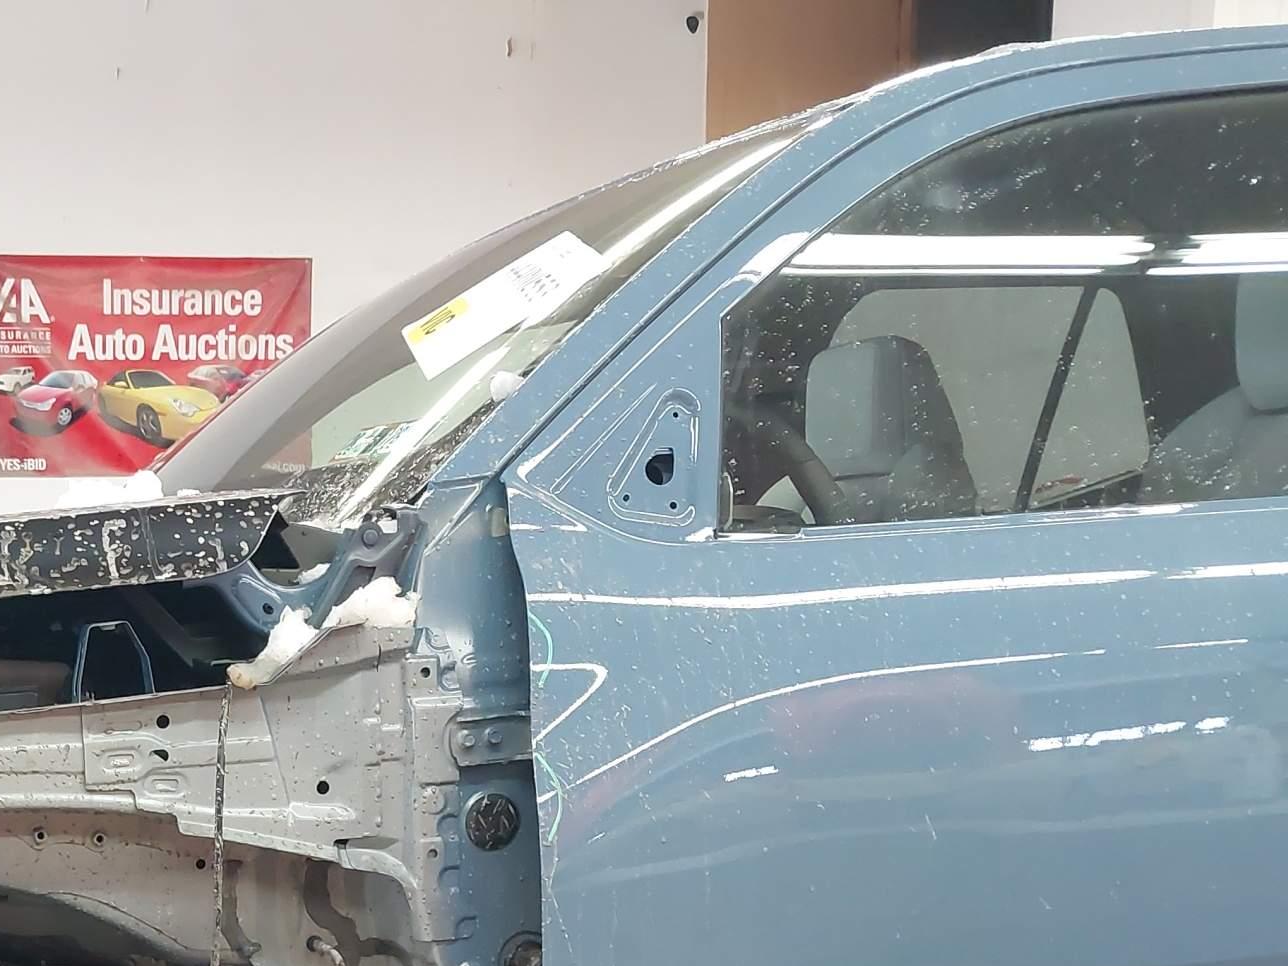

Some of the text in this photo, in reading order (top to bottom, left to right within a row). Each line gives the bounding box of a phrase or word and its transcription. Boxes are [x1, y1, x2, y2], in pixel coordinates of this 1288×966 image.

[103, 278, 263, 316] Insurance
[68, 323, 294, 361] Auto Auctions
